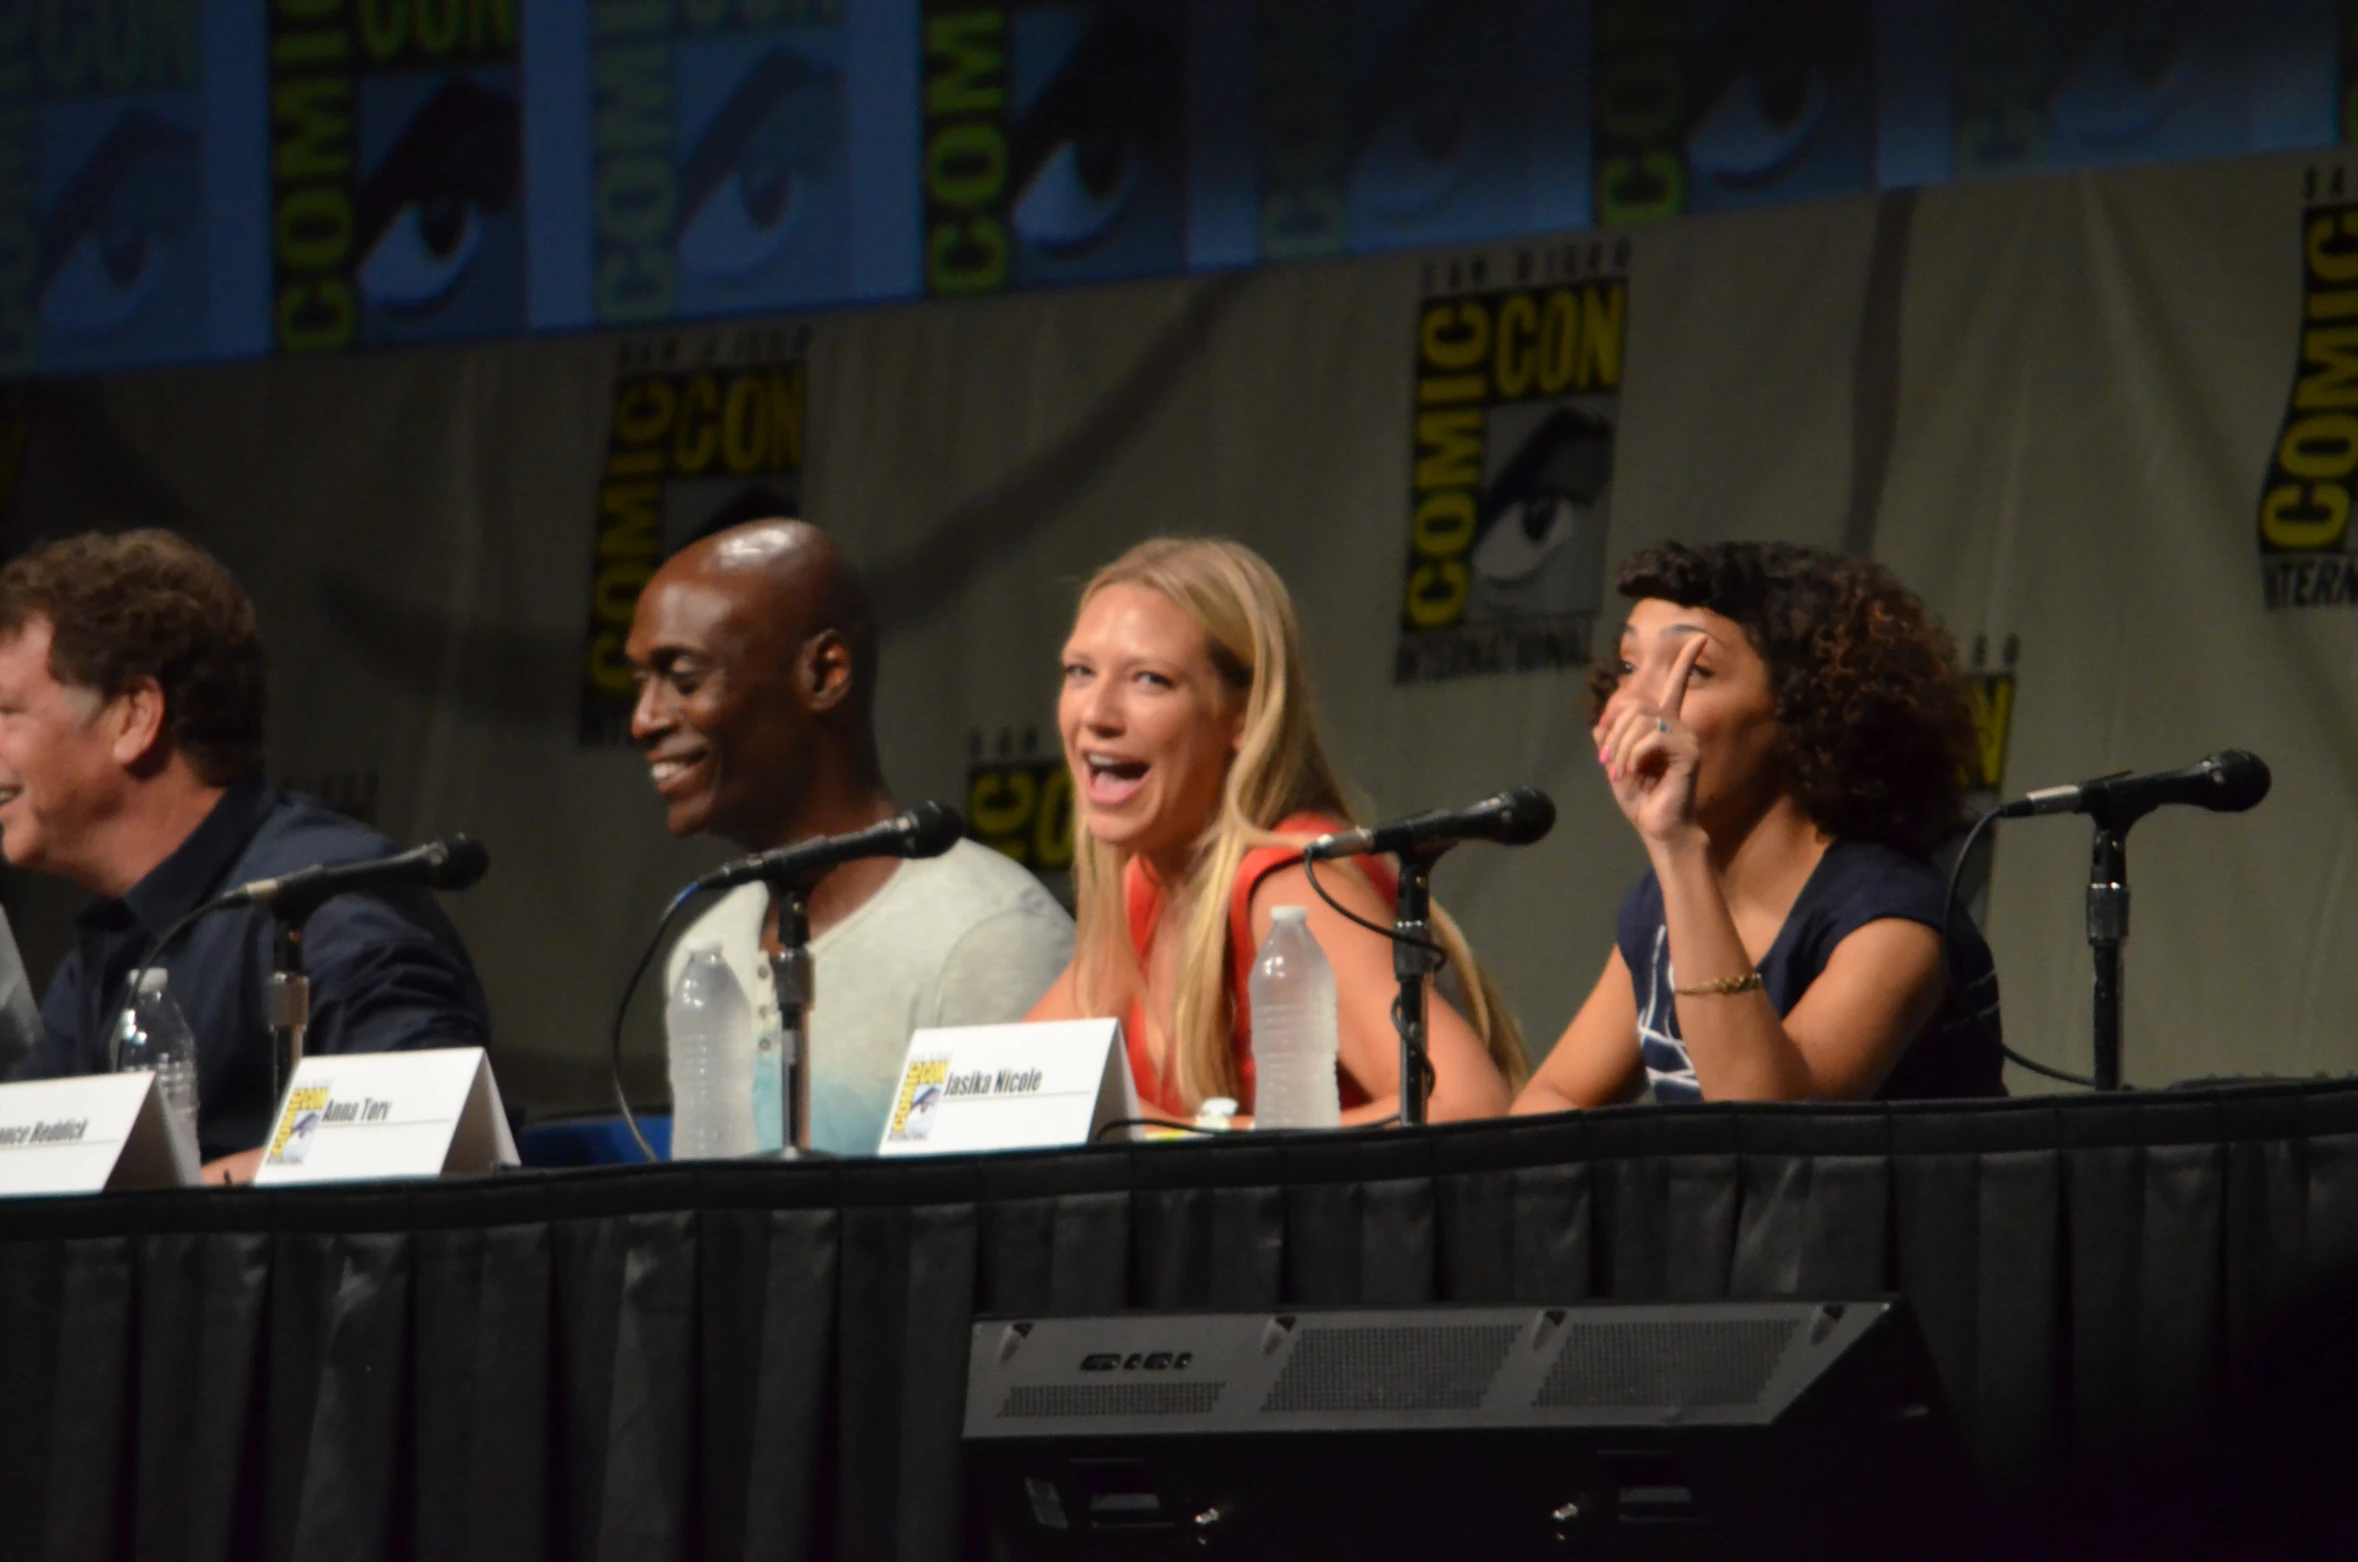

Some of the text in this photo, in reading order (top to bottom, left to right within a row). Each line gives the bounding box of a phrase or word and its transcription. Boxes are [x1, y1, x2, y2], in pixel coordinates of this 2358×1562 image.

[278, 0, 355, 352] COMI
[1494, 283, 1625, 399] CON
[674, 372, 806, 475] CON
[1406, 303, 1490, 632] COMIC
[322, 1098, 359, 1122] Anna
[944, 1067, 1043, 1096] Jasika Nicole
